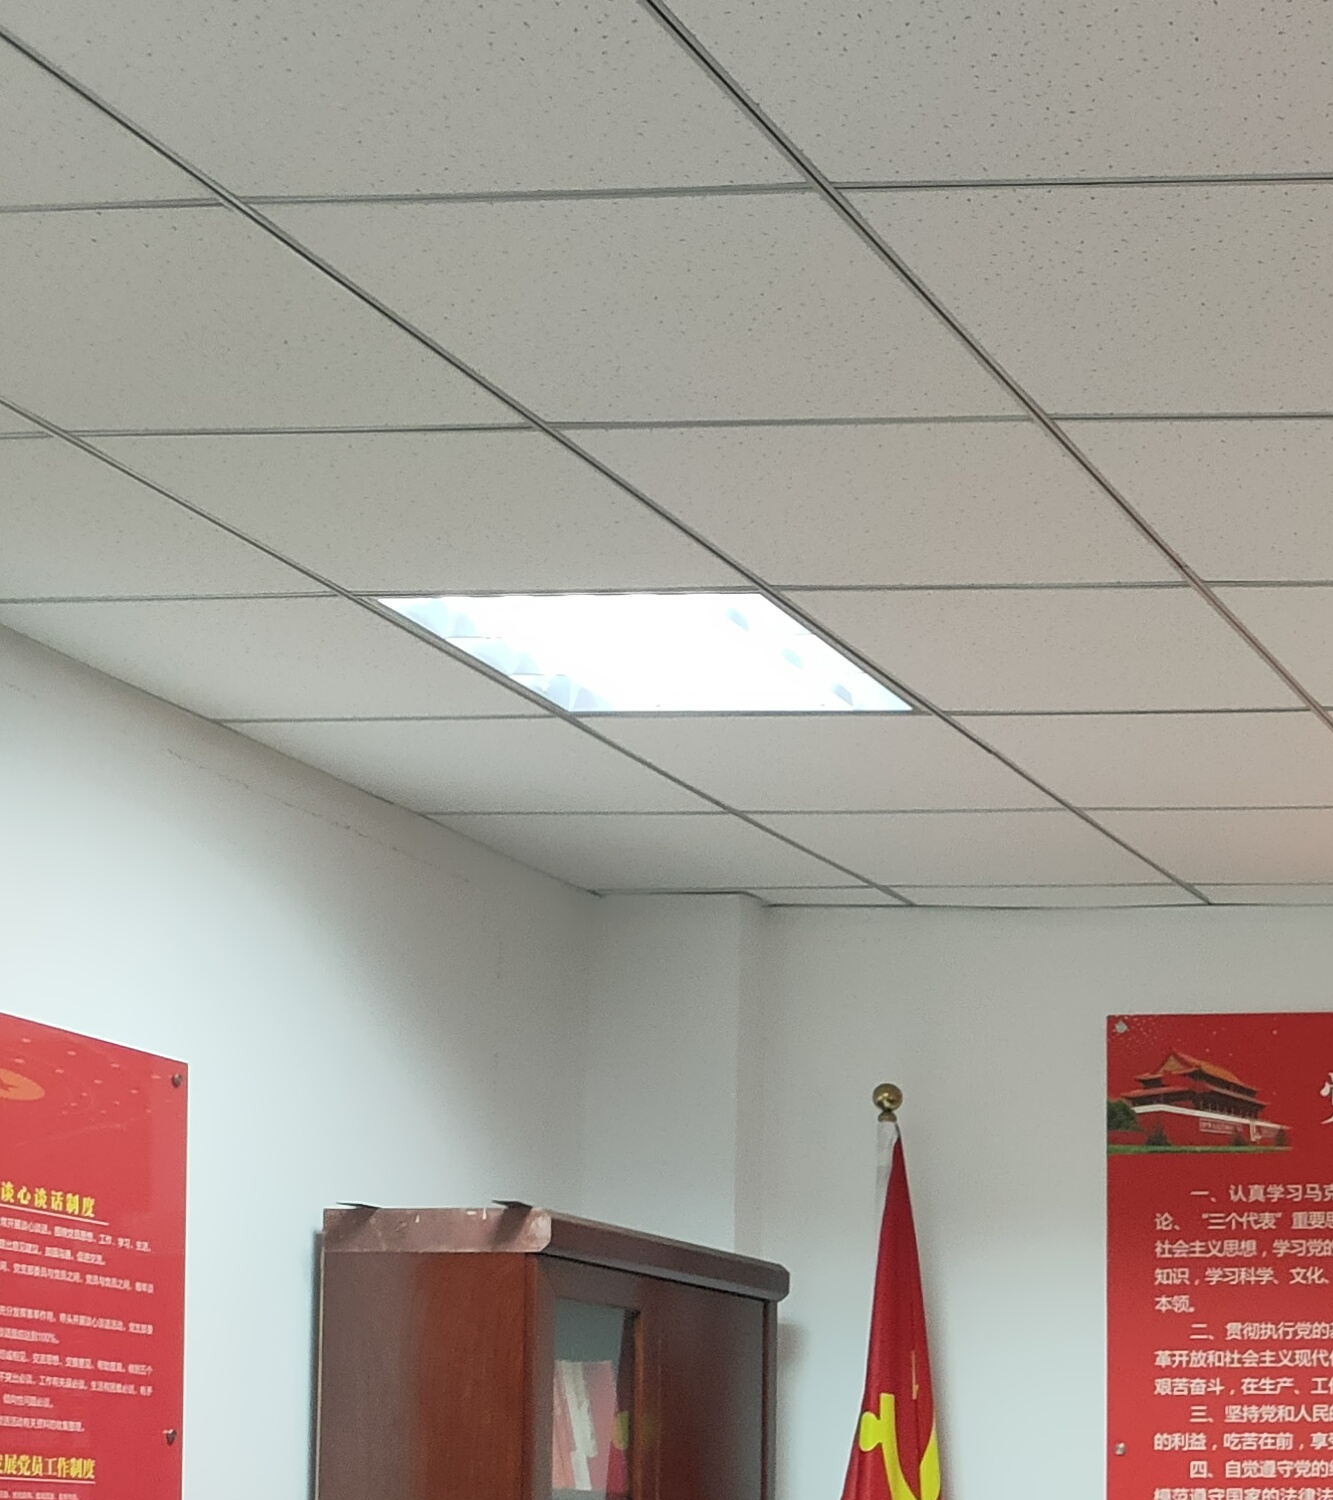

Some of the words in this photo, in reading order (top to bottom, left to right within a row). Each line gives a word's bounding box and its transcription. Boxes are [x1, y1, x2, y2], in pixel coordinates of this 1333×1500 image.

[1155, 1296, 1194, 1312] 本领。
[0, 1454, 95, 1479] 展党员工作制度
